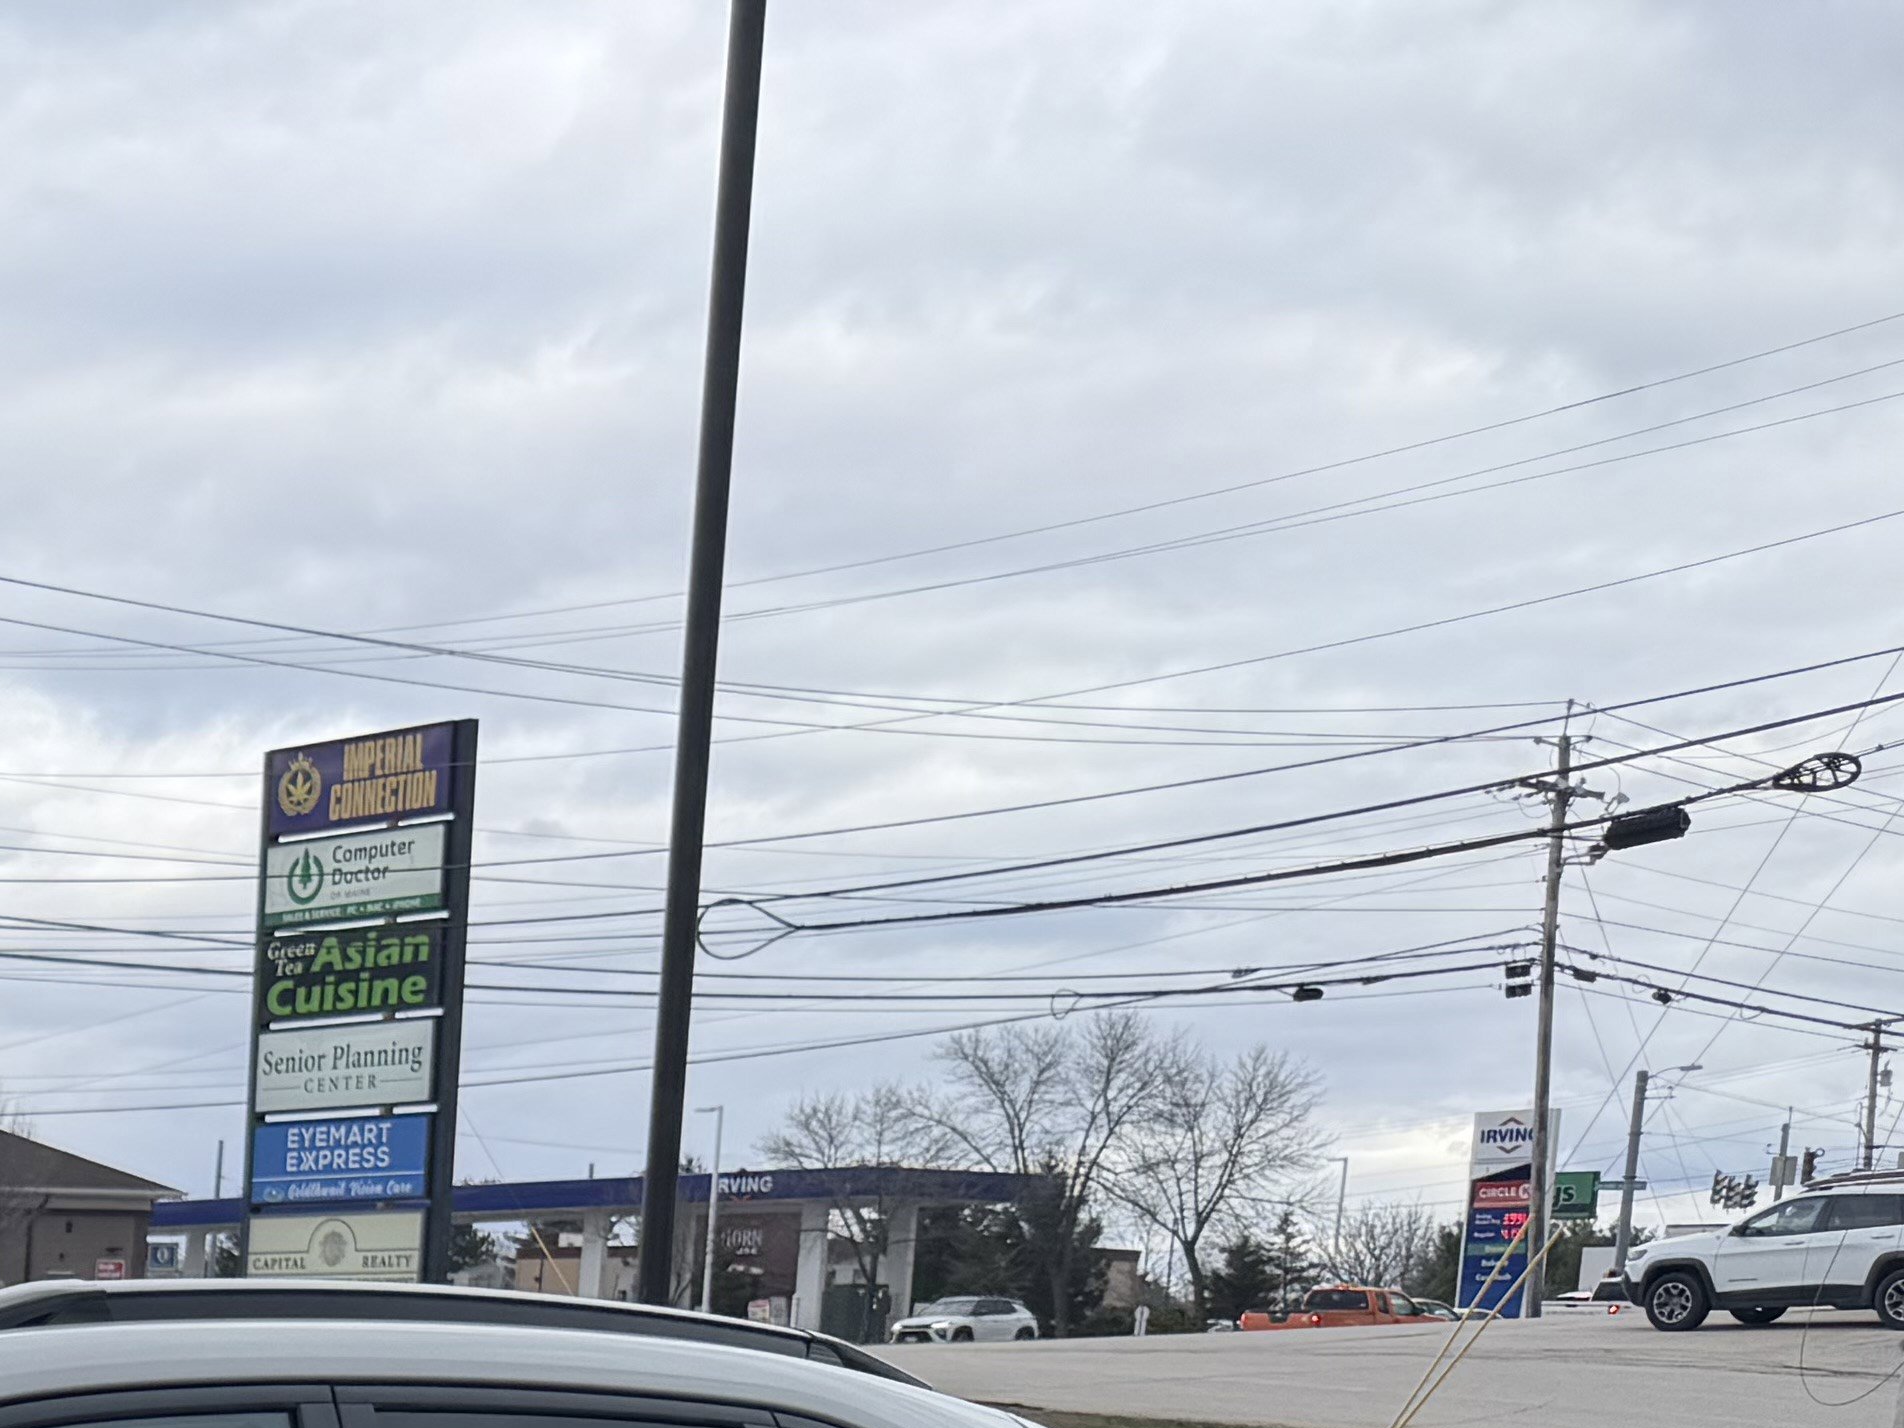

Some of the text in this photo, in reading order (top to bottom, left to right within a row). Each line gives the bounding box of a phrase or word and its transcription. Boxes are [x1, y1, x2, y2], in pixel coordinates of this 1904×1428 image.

[343, 733, 423, 781] IMPERIAL
[329, 770, 437, 821] CONNECTION
[332, 839, 415, 863] Computer
[332, 865, 389, 886] Doctor
[267, 931, 430, 973] Green Asian
[275, 959, 303, 976] Tea
[267, 971, 427, 1016] Cuisine
[262, 1041, 423, 1076] Senior Planning
[304, 1074, 377, 1093] CENTER
[287, 1123, 391, 1149] EYEMART
[285, 1147, 390, 1172] EXPRESS
[1479, 1186, 1516, 1199] CIRCLE
[252, 1254, 412, 1271] CAPITAL REALTY
